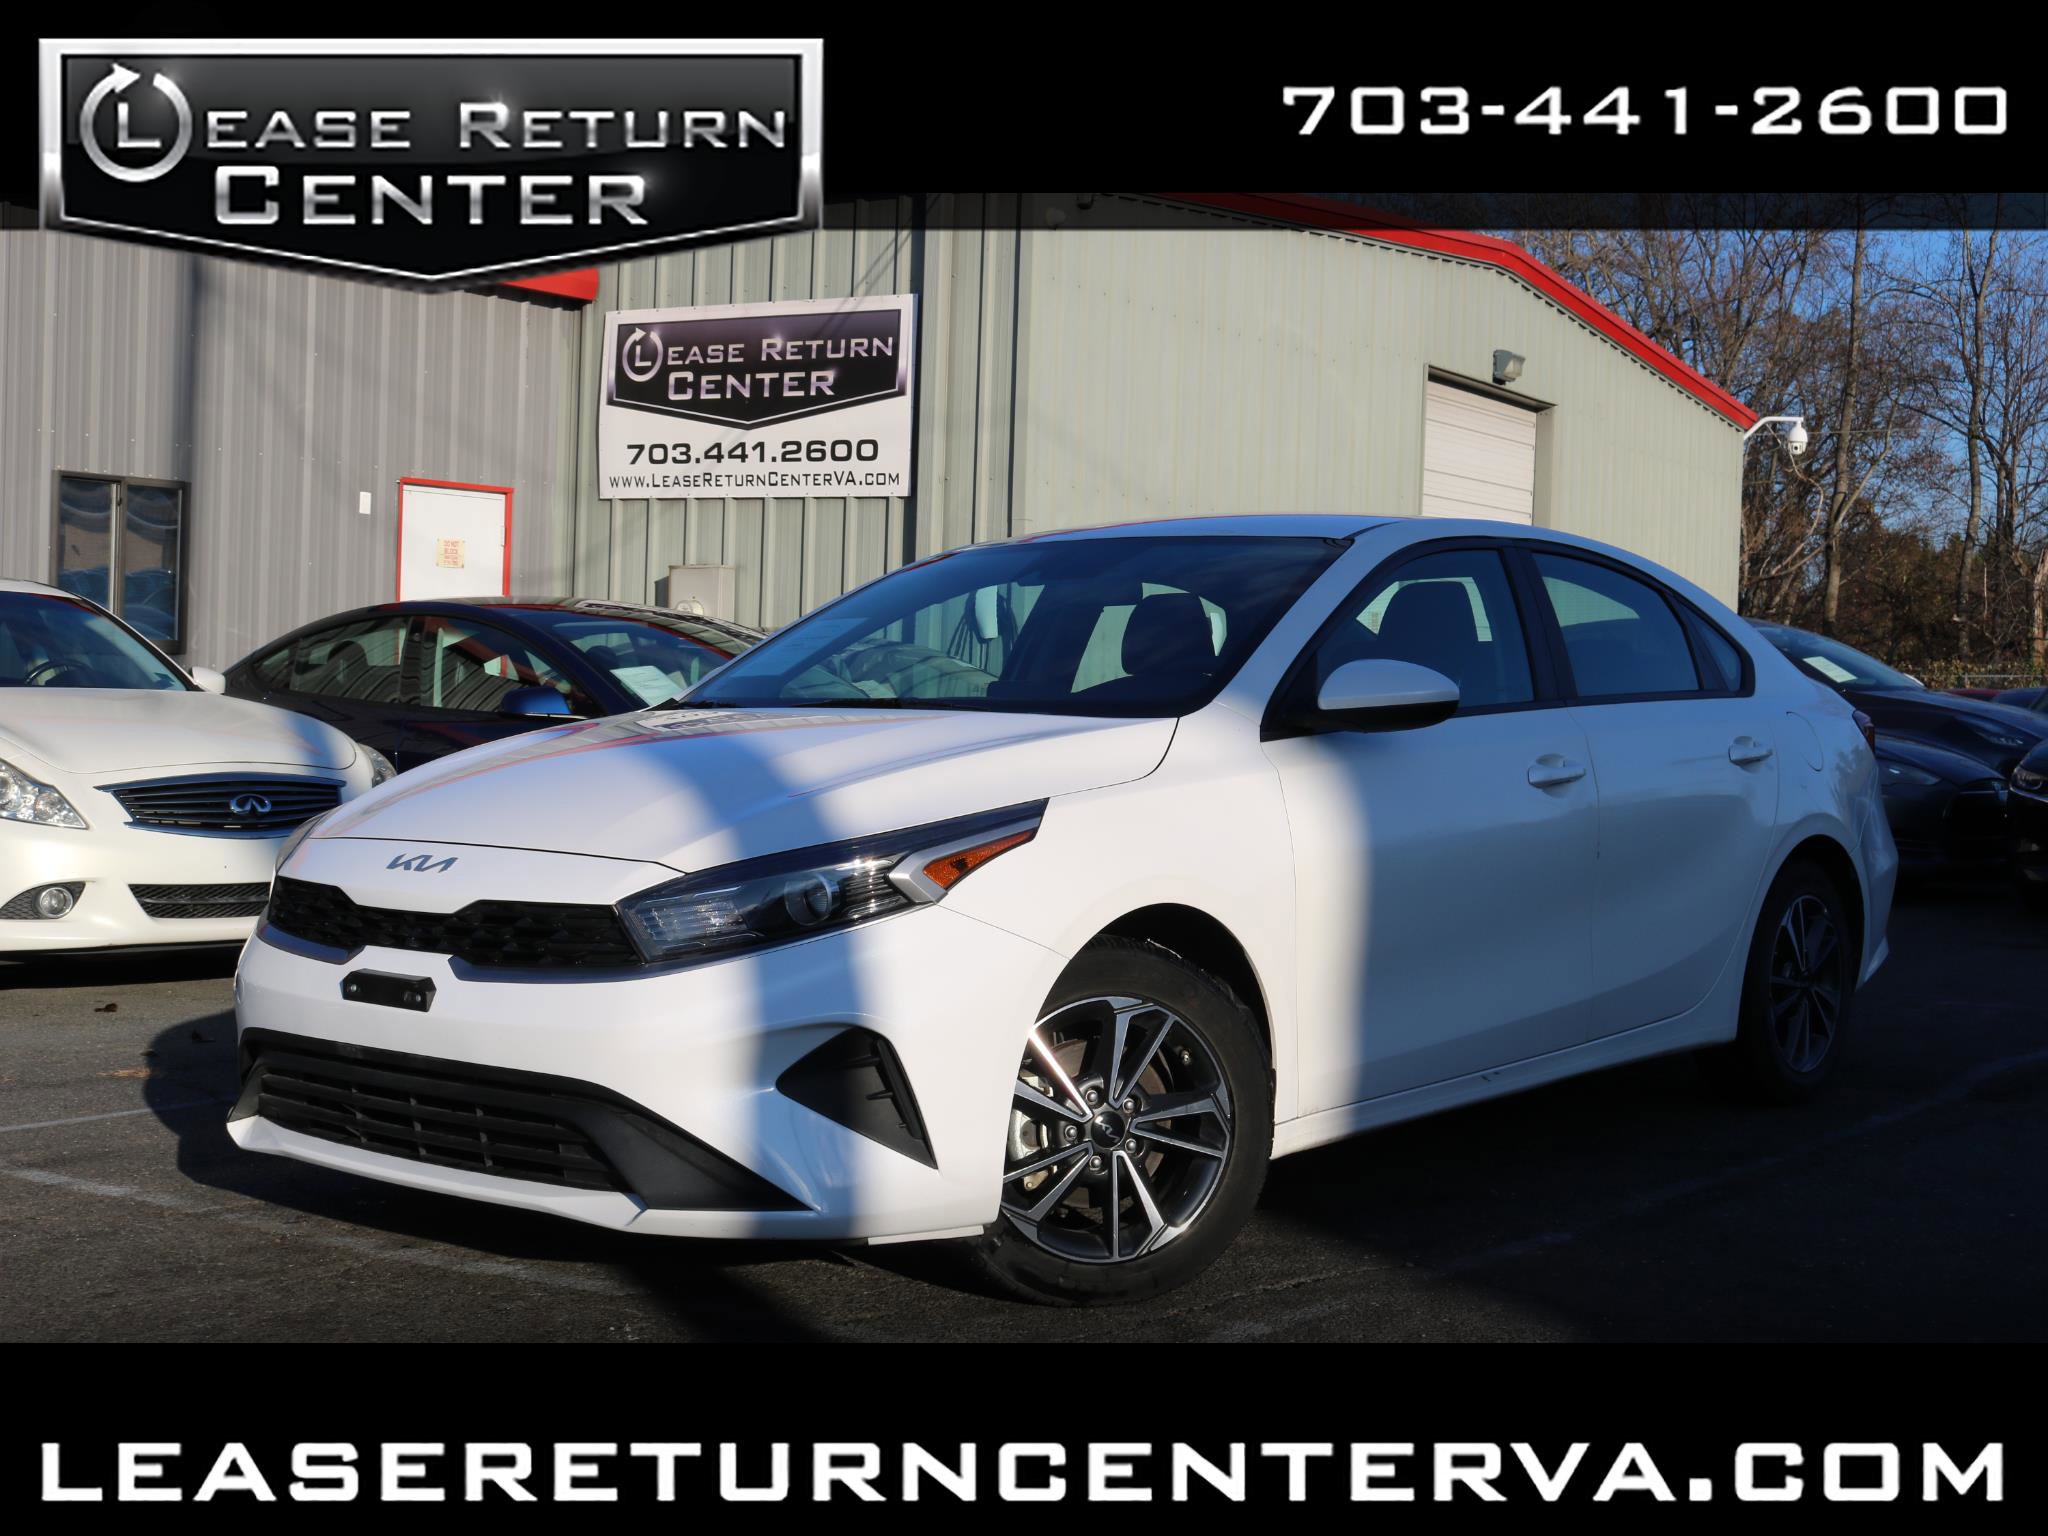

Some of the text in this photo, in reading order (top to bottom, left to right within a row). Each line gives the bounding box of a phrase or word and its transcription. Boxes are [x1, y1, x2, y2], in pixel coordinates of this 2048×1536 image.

[761, 337, 894, 361] RETURN
[668, 370, 836, 400] CENTER
[626, 438, 879, 465] 703.441.2600
